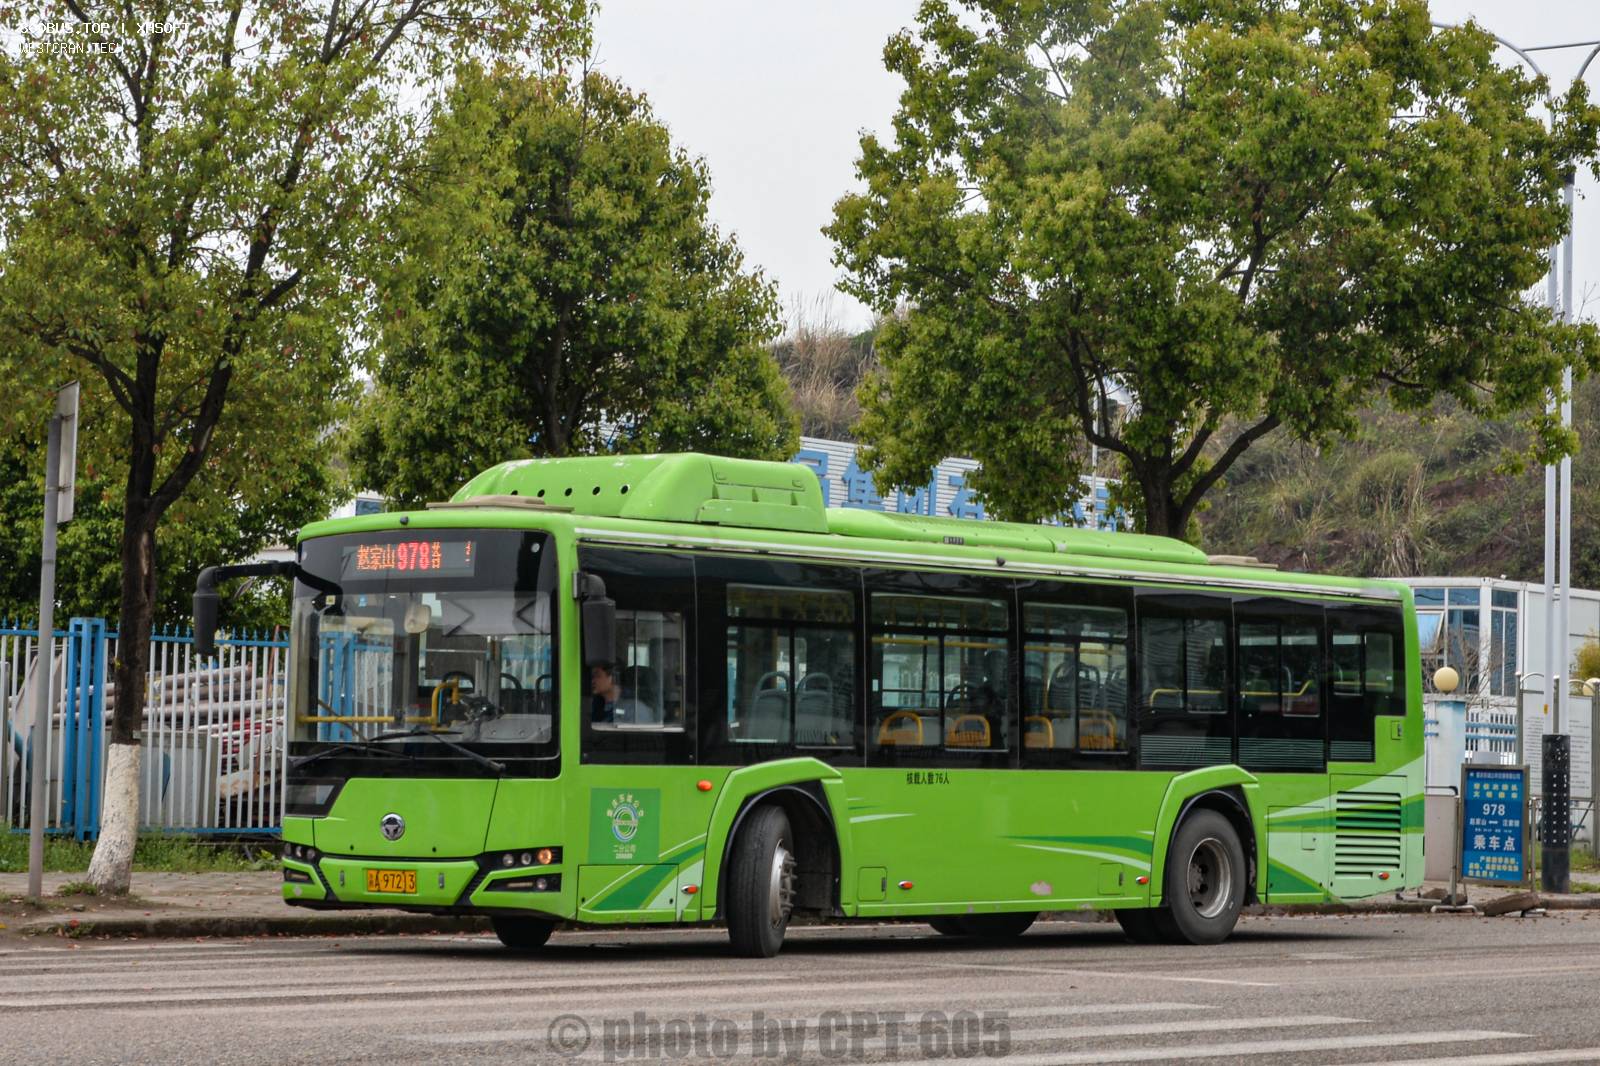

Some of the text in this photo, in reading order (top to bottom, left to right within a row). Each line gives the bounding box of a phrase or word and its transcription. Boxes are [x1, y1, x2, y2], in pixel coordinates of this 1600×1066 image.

[397, 541, 430, 571] 978
[1482, 803, 1506, 816] 978
[1473, 834, 1516, 852] 乘车点
